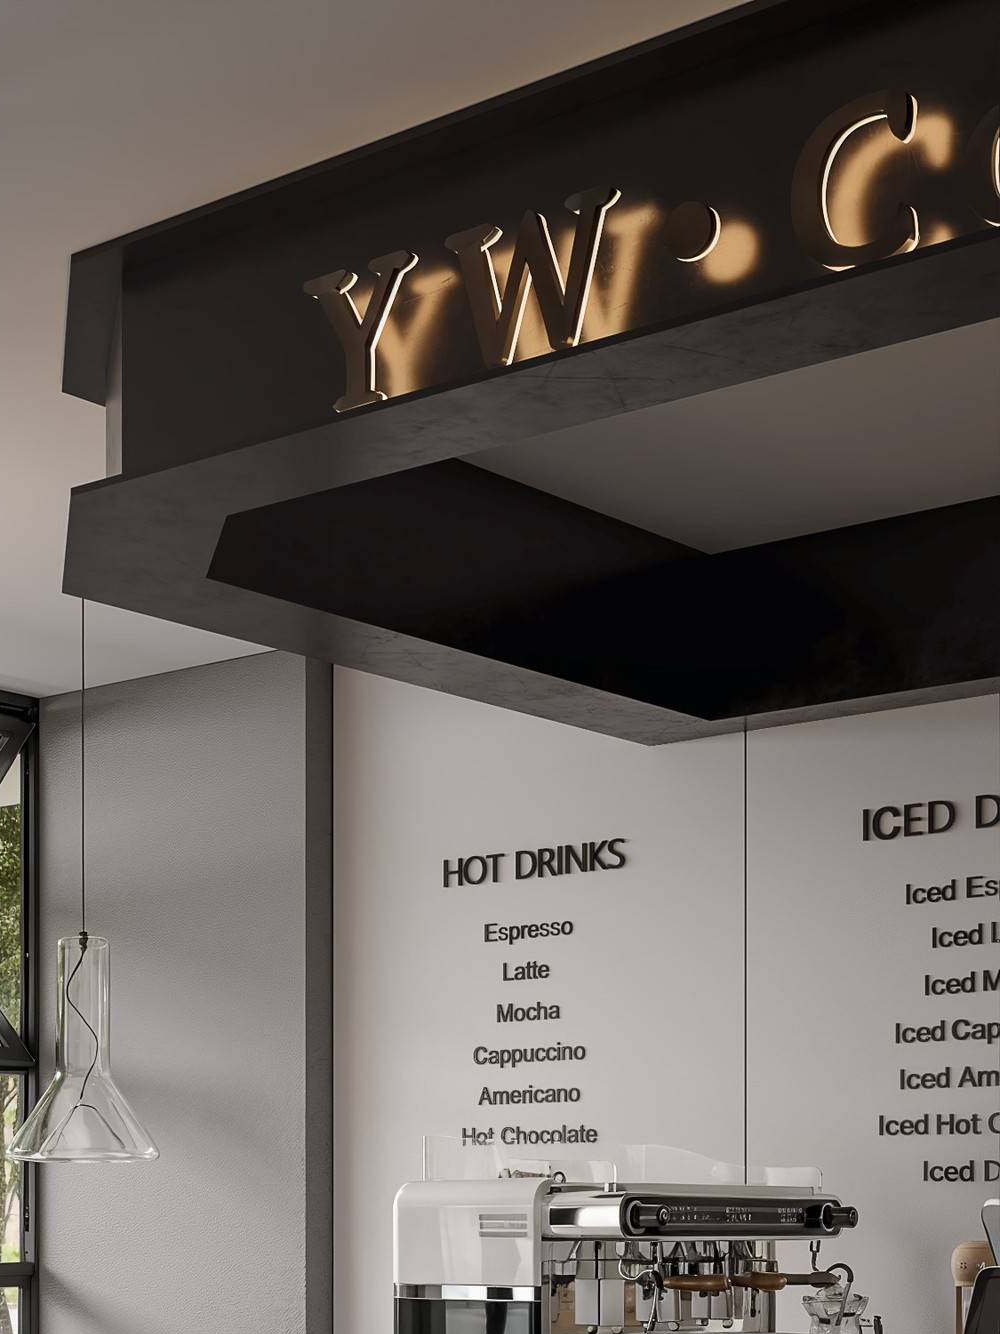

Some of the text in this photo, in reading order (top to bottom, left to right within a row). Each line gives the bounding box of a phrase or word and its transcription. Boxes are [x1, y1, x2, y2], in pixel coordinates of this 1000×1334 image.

[863, 801, 957, 841] ICED
[444, 838, 626, 887] HOT DRINKS
[906, 879, 956, 904] Iced
[485, 921, 573, 945] Espresso
[932, 923, 983, 948] Iced
[503, 961, 549, 981] Latte
[925, 971, 976, 995] Iced
[497, 1002, 560, 1022] Mocha
[896, 1020, 945, 1043] Iced
[474, 1042, 586, 1068] Cappuccino
[901, 1067, 950, 1089] Iced
[478, 1085, 580, 1105] Americano
[462, 1125, 597, 1146] Hot Chocolate
[879, 1114, 928, 1135] Iced
[937, 1114, 982, 1134] Hot
[924, 1160, 974, 1182] Iced
